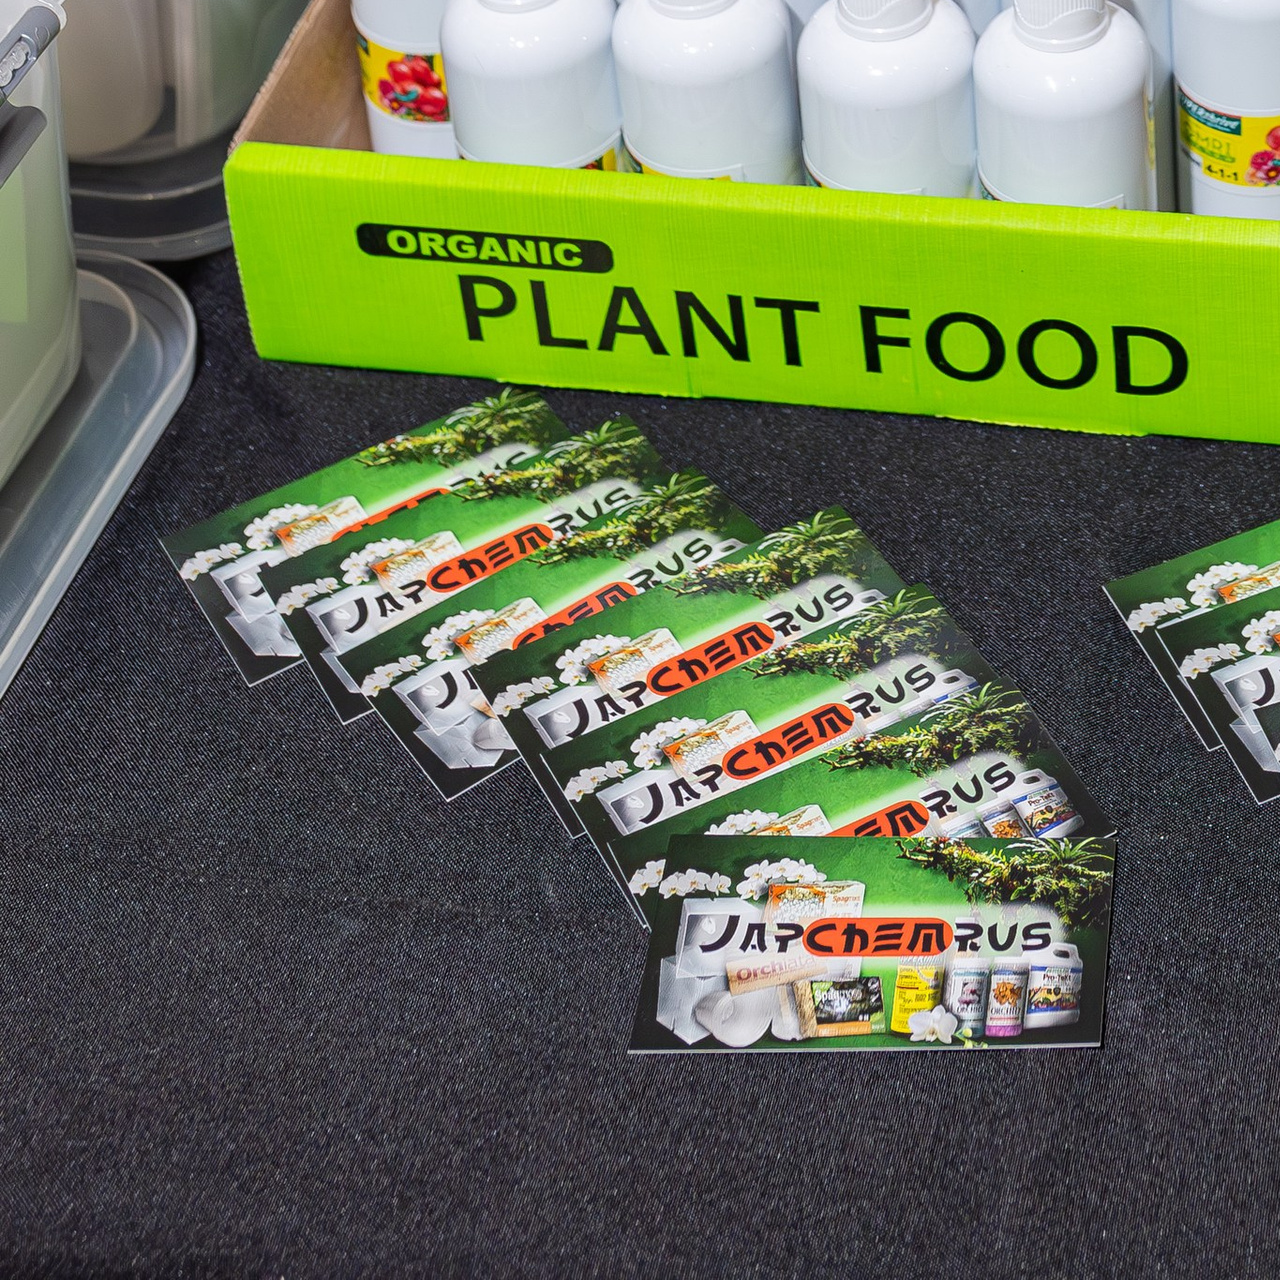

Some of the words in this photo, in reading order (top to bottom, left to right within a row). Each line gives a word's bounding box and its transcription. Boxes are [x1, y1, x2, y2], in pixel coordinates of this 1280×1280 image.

[1205, 165, 1239, 181] 4-1-1
[385, 227, 584, 268] ORGANIC
[456, 271, 821, 368] PLANT
[858, 302, 1192, 398] FOOD
[736, 955, 815, 983] Orchiata
